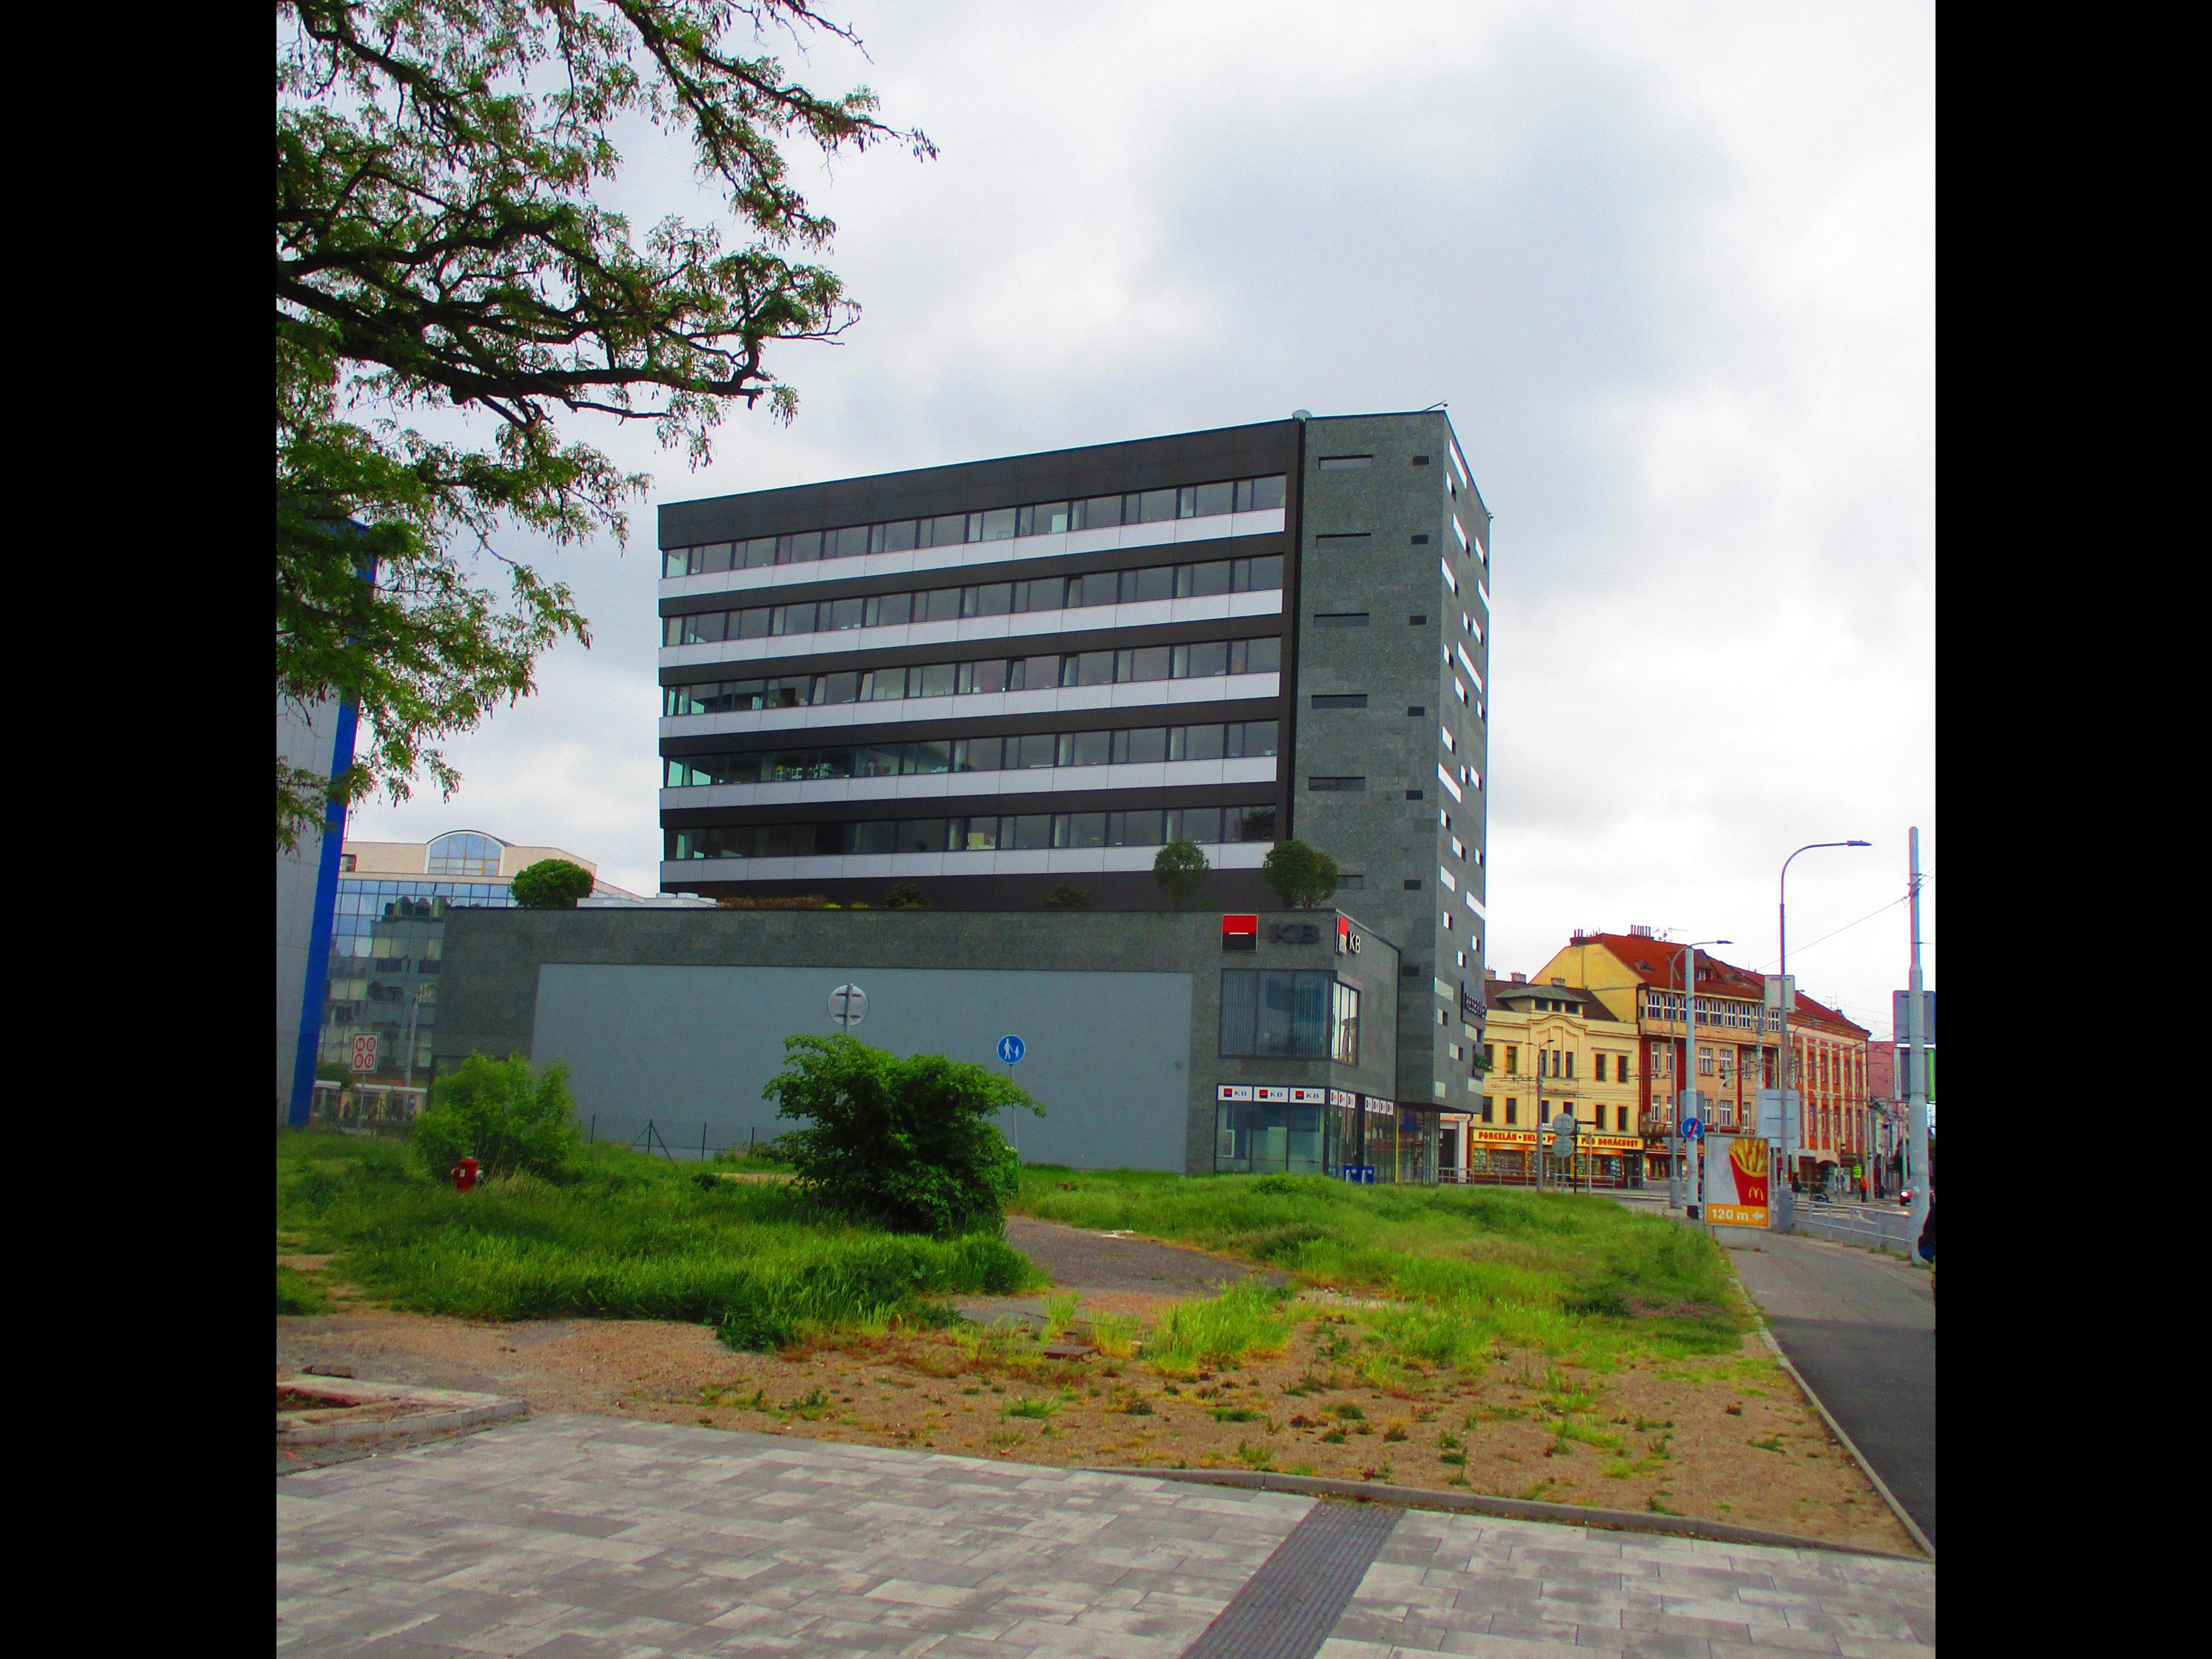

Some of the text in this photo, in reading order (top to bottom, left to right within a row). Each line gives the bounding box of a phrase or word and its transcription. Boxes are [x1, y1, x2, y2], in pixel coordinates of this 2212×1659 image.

[1270, 923, 1319, 944] KB
[1348, 931, 1361, 953] KB
[1478, 1131, 1537, 1142] PORCELÁN SKL
[1712, 1209, 1749, 1221] 120 m
